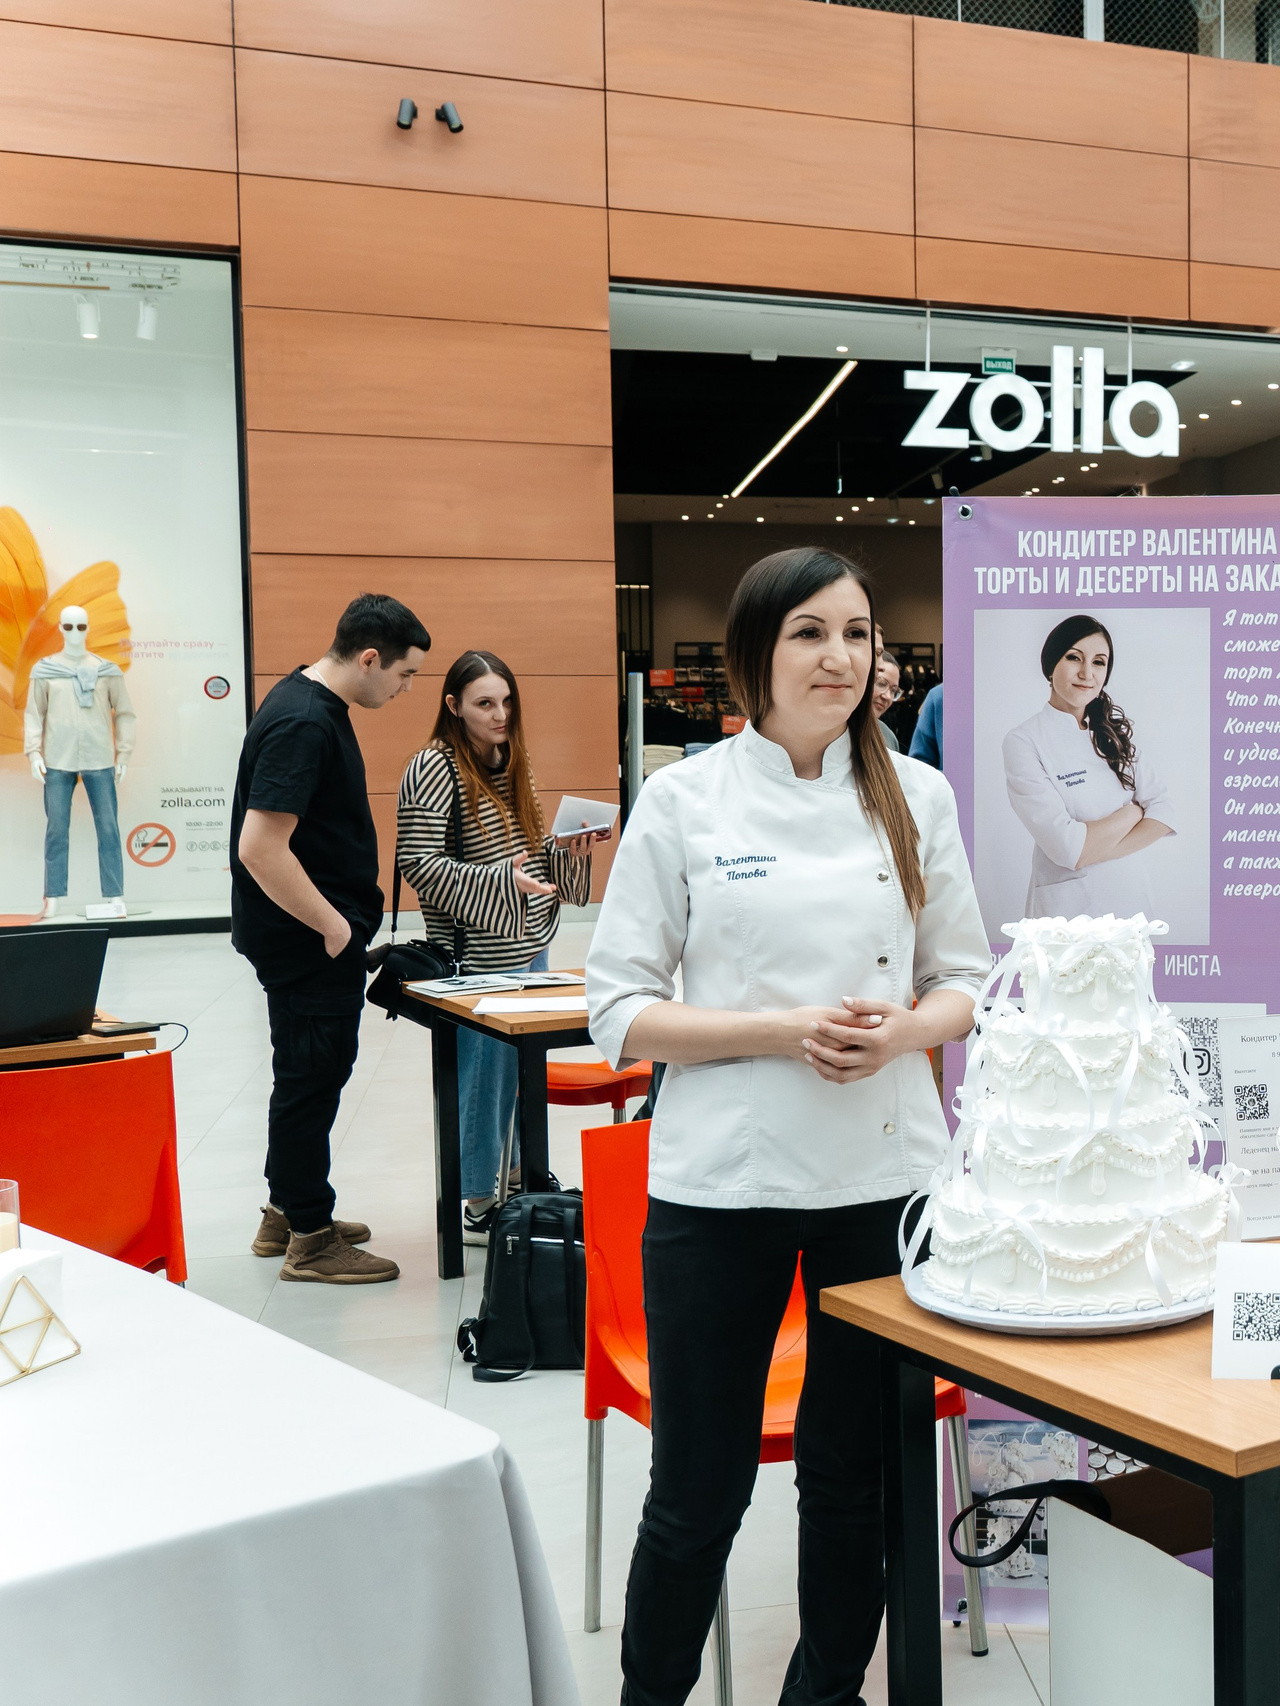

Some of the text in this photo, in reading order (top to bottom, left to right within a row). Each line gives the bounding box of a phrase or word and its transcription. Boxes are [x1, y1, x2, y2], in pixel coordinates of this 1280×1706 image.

[901, 345, 1180, 457] zolla
[1017, 528, 1137, 561] КОНДИТЕР
[1142, 526, 1277, 557] ВАЛЕНТИНА
[974, 565, 1049, 595] ТОРТЫ
[1055, 565, 1070, 594] И
[1075, 564, 1183, 597] ДЕСЕРТЫ
[1188, 564, 1220, 593] НА
[1222, 608, 1237, 626] Я
[1239, 611, 1278, 626] тот
[183, 640, 215, 650] сразу
[1223, 665, 1273, 683] торт
[1225, 690, 1259, 707] Что
[1223, 748, 1234, 761] и
[160, 797, 226, 808] zolla.com
[1224, 798, 1246, 815] Он
[714, 855, 777, 867] Валентина
[1223, 856, 1235, 869] а
[726, 868, 768, 881] Попова
[1163, 954, 1222, 978] ИНСТА
[1240, 1033, 1277, 1043] Кондитер
[1240, 1146, 1270, 1155] Леденец
